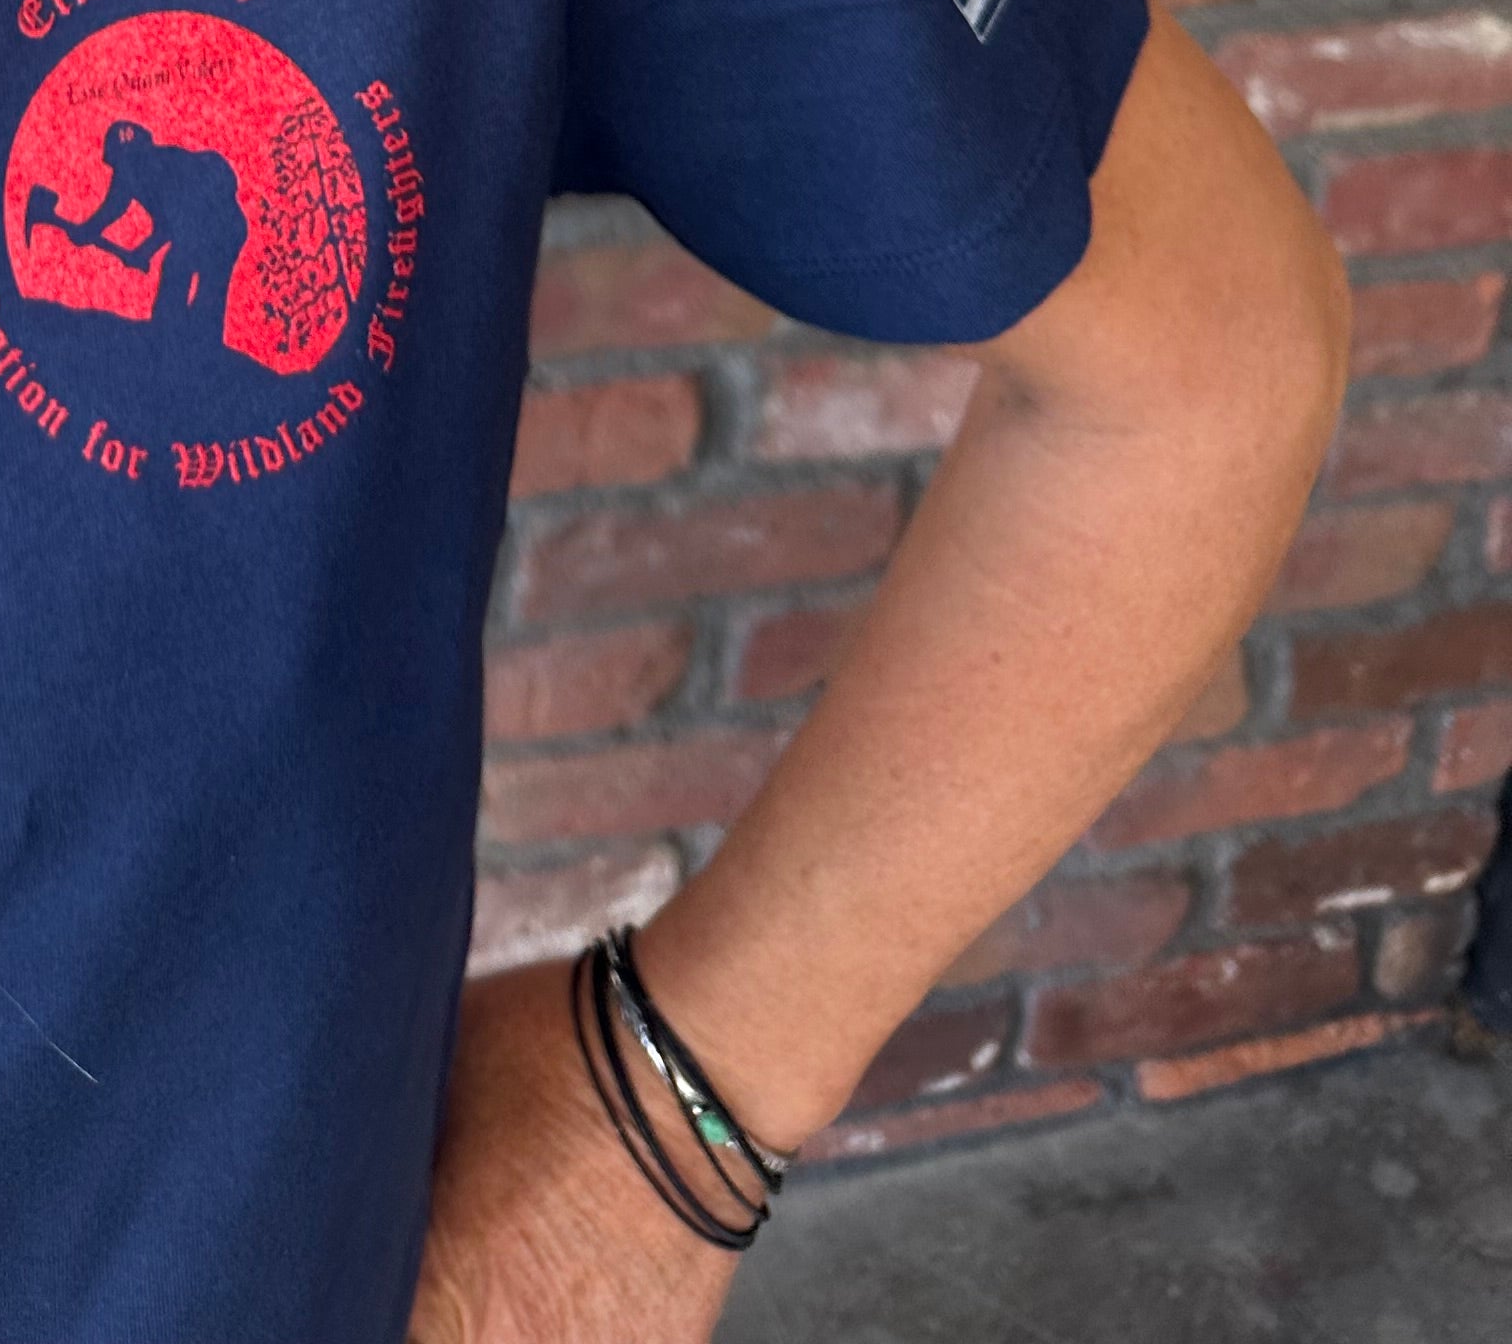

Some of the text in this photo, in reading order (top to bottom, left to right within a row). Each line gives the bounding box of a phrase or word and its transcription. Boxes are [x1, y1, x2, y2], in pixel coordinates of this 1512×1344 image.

[82, 419, 149, 480] for
[171, 380, 366, 489] Wildland
[354, 78, 426, 372] Firefighters
